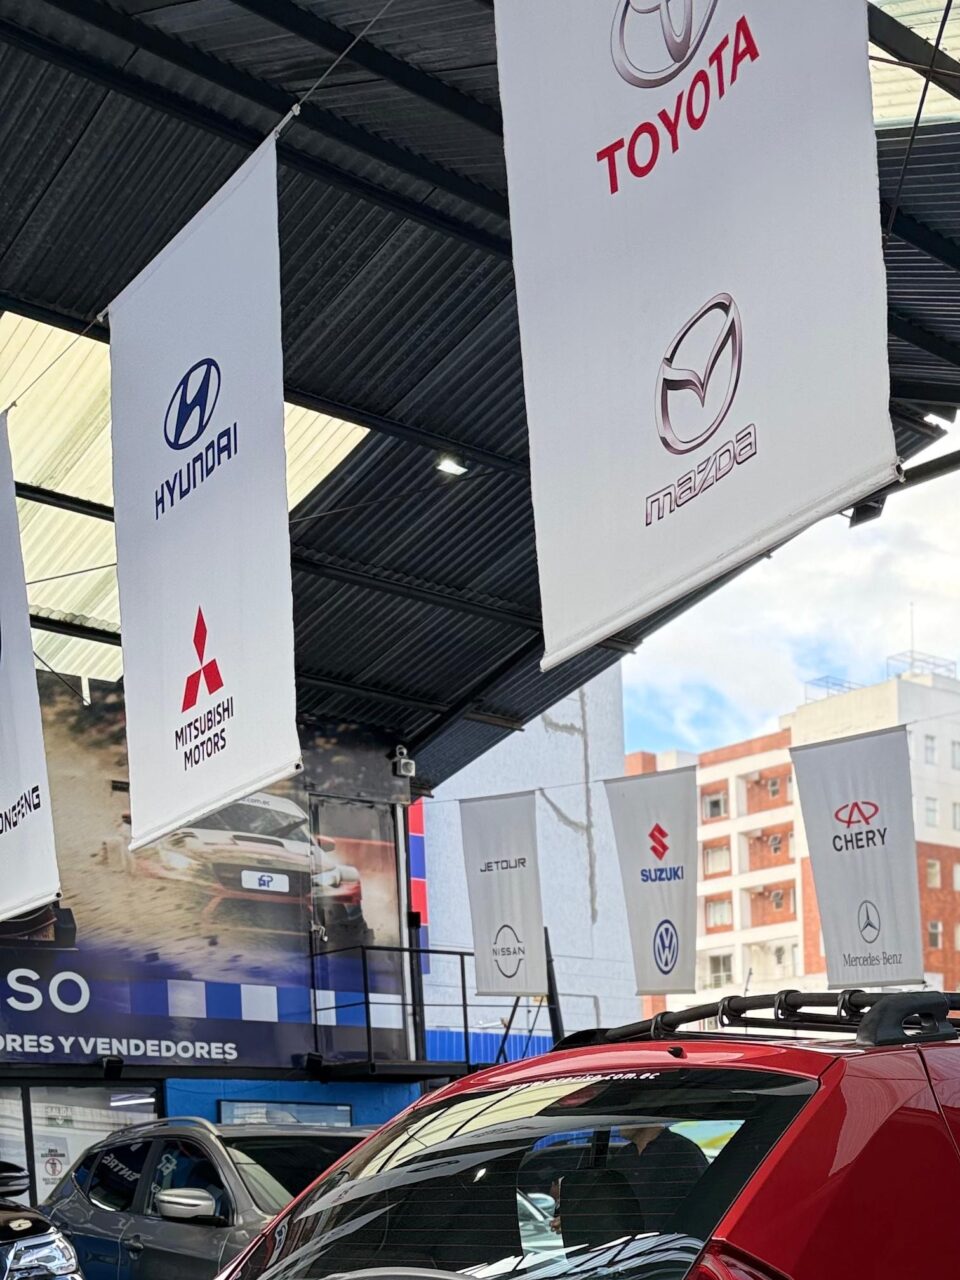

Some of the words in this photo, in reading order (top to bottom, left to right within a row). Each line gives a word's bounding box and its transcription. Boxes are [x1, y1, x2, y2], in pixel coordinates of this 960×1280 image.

[596, 15, 760, 195] TOYOTA
[155, 421, 238, 520] HYUNDAI
[175, 696, 234, 750] MITSUBISHI
[183, 727, 227, 771] MOTORS
[832, 827, 888, 853] CHERY
[480, 857, 526, 873] JETOUR
[640, 865, 684, 883] SUZUKI
[492, 946, 526, 957] NISSAN
[843, 951, 902, 967] Mercedes-Benz
[58, 1036, 75, 1054] Y
[78, 1037, 238, 1060] VENDEDORES
